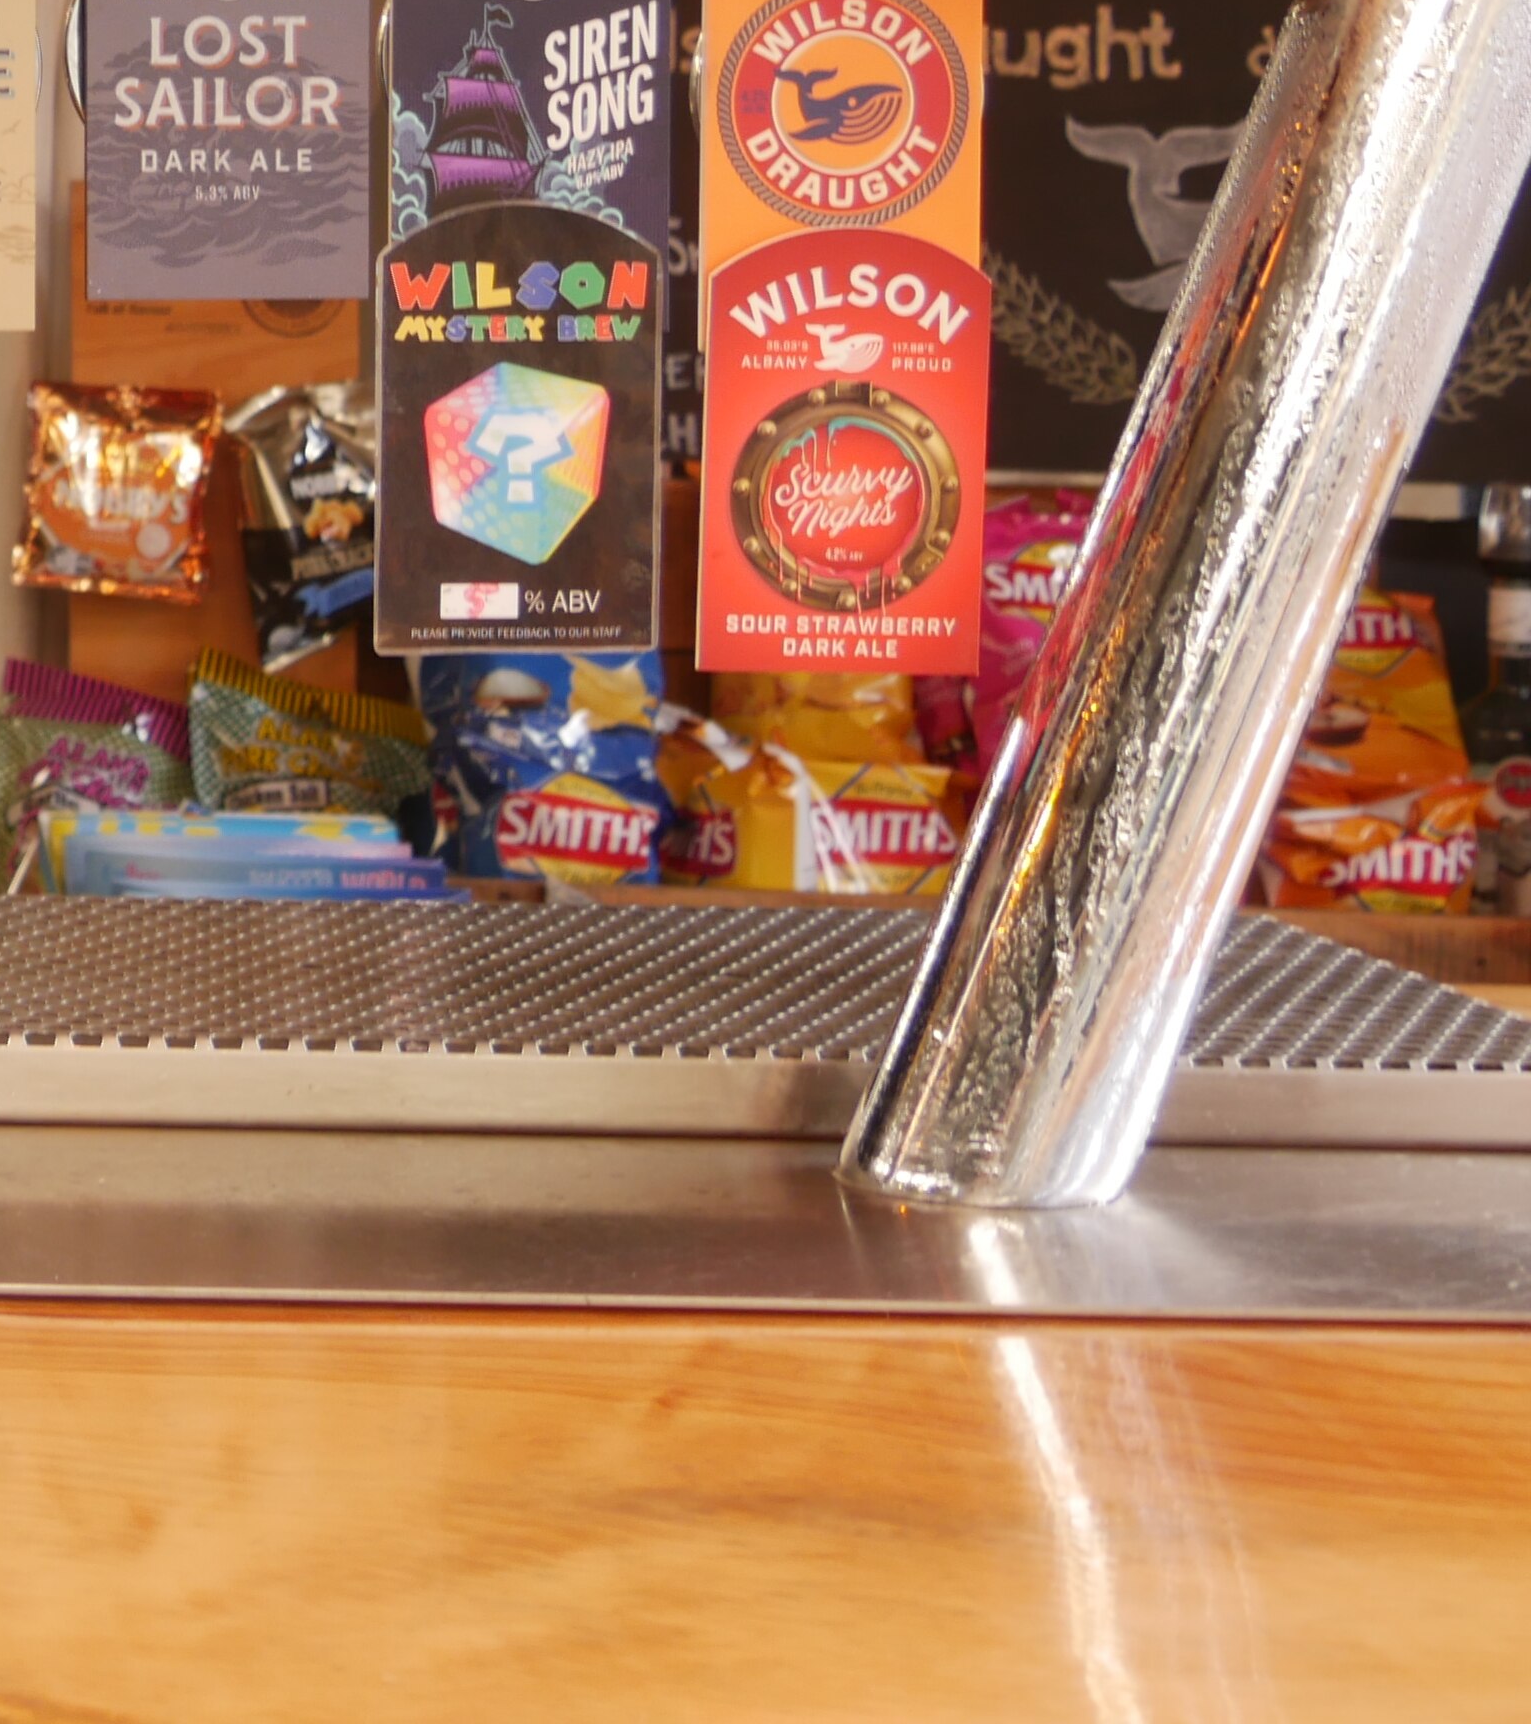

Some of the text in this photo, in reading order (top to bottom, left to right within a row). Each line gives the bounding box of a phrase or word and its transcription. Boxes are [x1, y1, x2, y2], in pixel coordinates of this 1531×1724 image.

[148, 14, 315, 69] LOST
[543, 0, 658, 92] SIREN
[112, 75, 344, 133] SAILOR
[546, 63, 655, 152] SONG
[140, 147, 314, 175] DARK ALE
[567, 135, 635, 176] HAZY IPA
[746, 124, 938, 210] DRAUGHT
[389, 260, 649, 311] WILSON
[728, 263, 970, 346] WILSON
[394, 314, 641, 343] MYSTERY BREW
[741, 354, 953, 372] ALBANY PROUD
[774, 462, 914, 508] Scurvy
[788, 498, 897, 540] Nights
[551, 589, 601, 614] ABV
[410, 627, 450, 641] PLEASE
[497, 627, 551, 641] FEEDBACK
[554, 626, 567, 640] TO
[568, 626, 591, 640] OUR
[592, 625, 622, 640] STAFF
[725, 614, 957, 637] SOUR STRAWBERRY
[782, 637, 899, 659] DARK ALE
